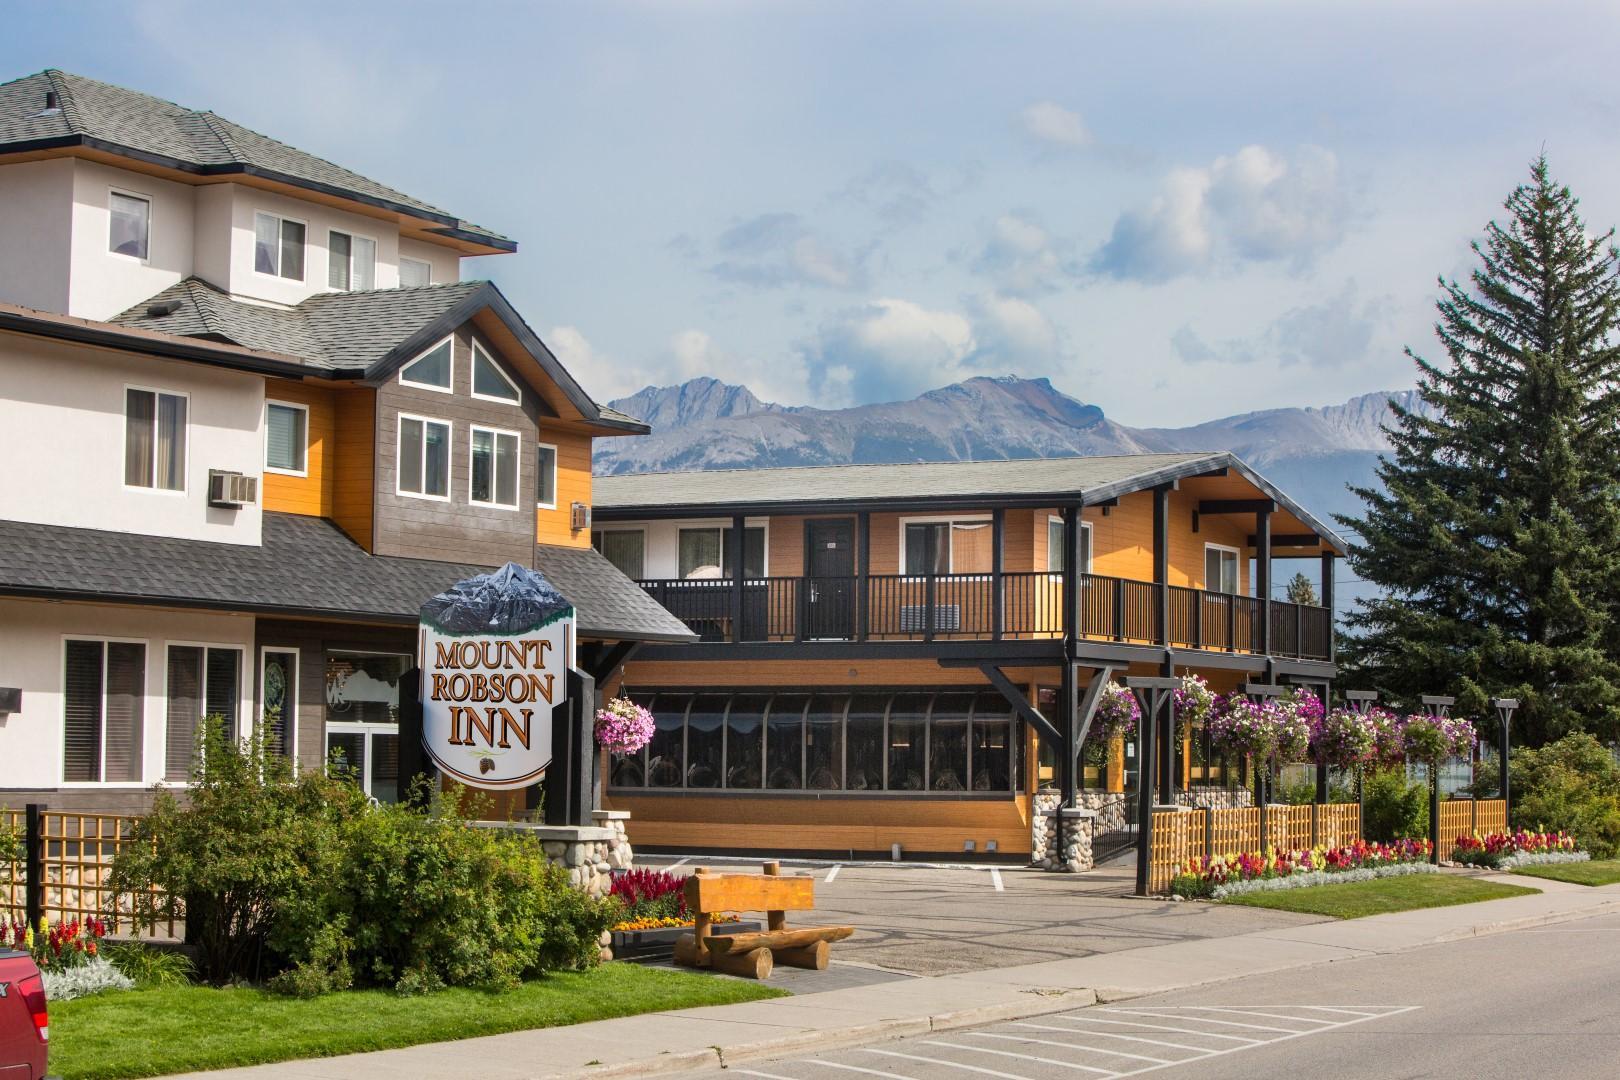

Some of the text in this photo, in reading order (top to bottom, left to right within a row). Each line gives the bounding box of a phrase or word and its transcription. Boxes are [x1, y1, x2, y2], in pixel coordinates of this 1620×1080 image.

[435, 640, 552, 669] MOUNT
[431, 673, 555, 704] ROBSON
[448, 706, 534, 750] INN
